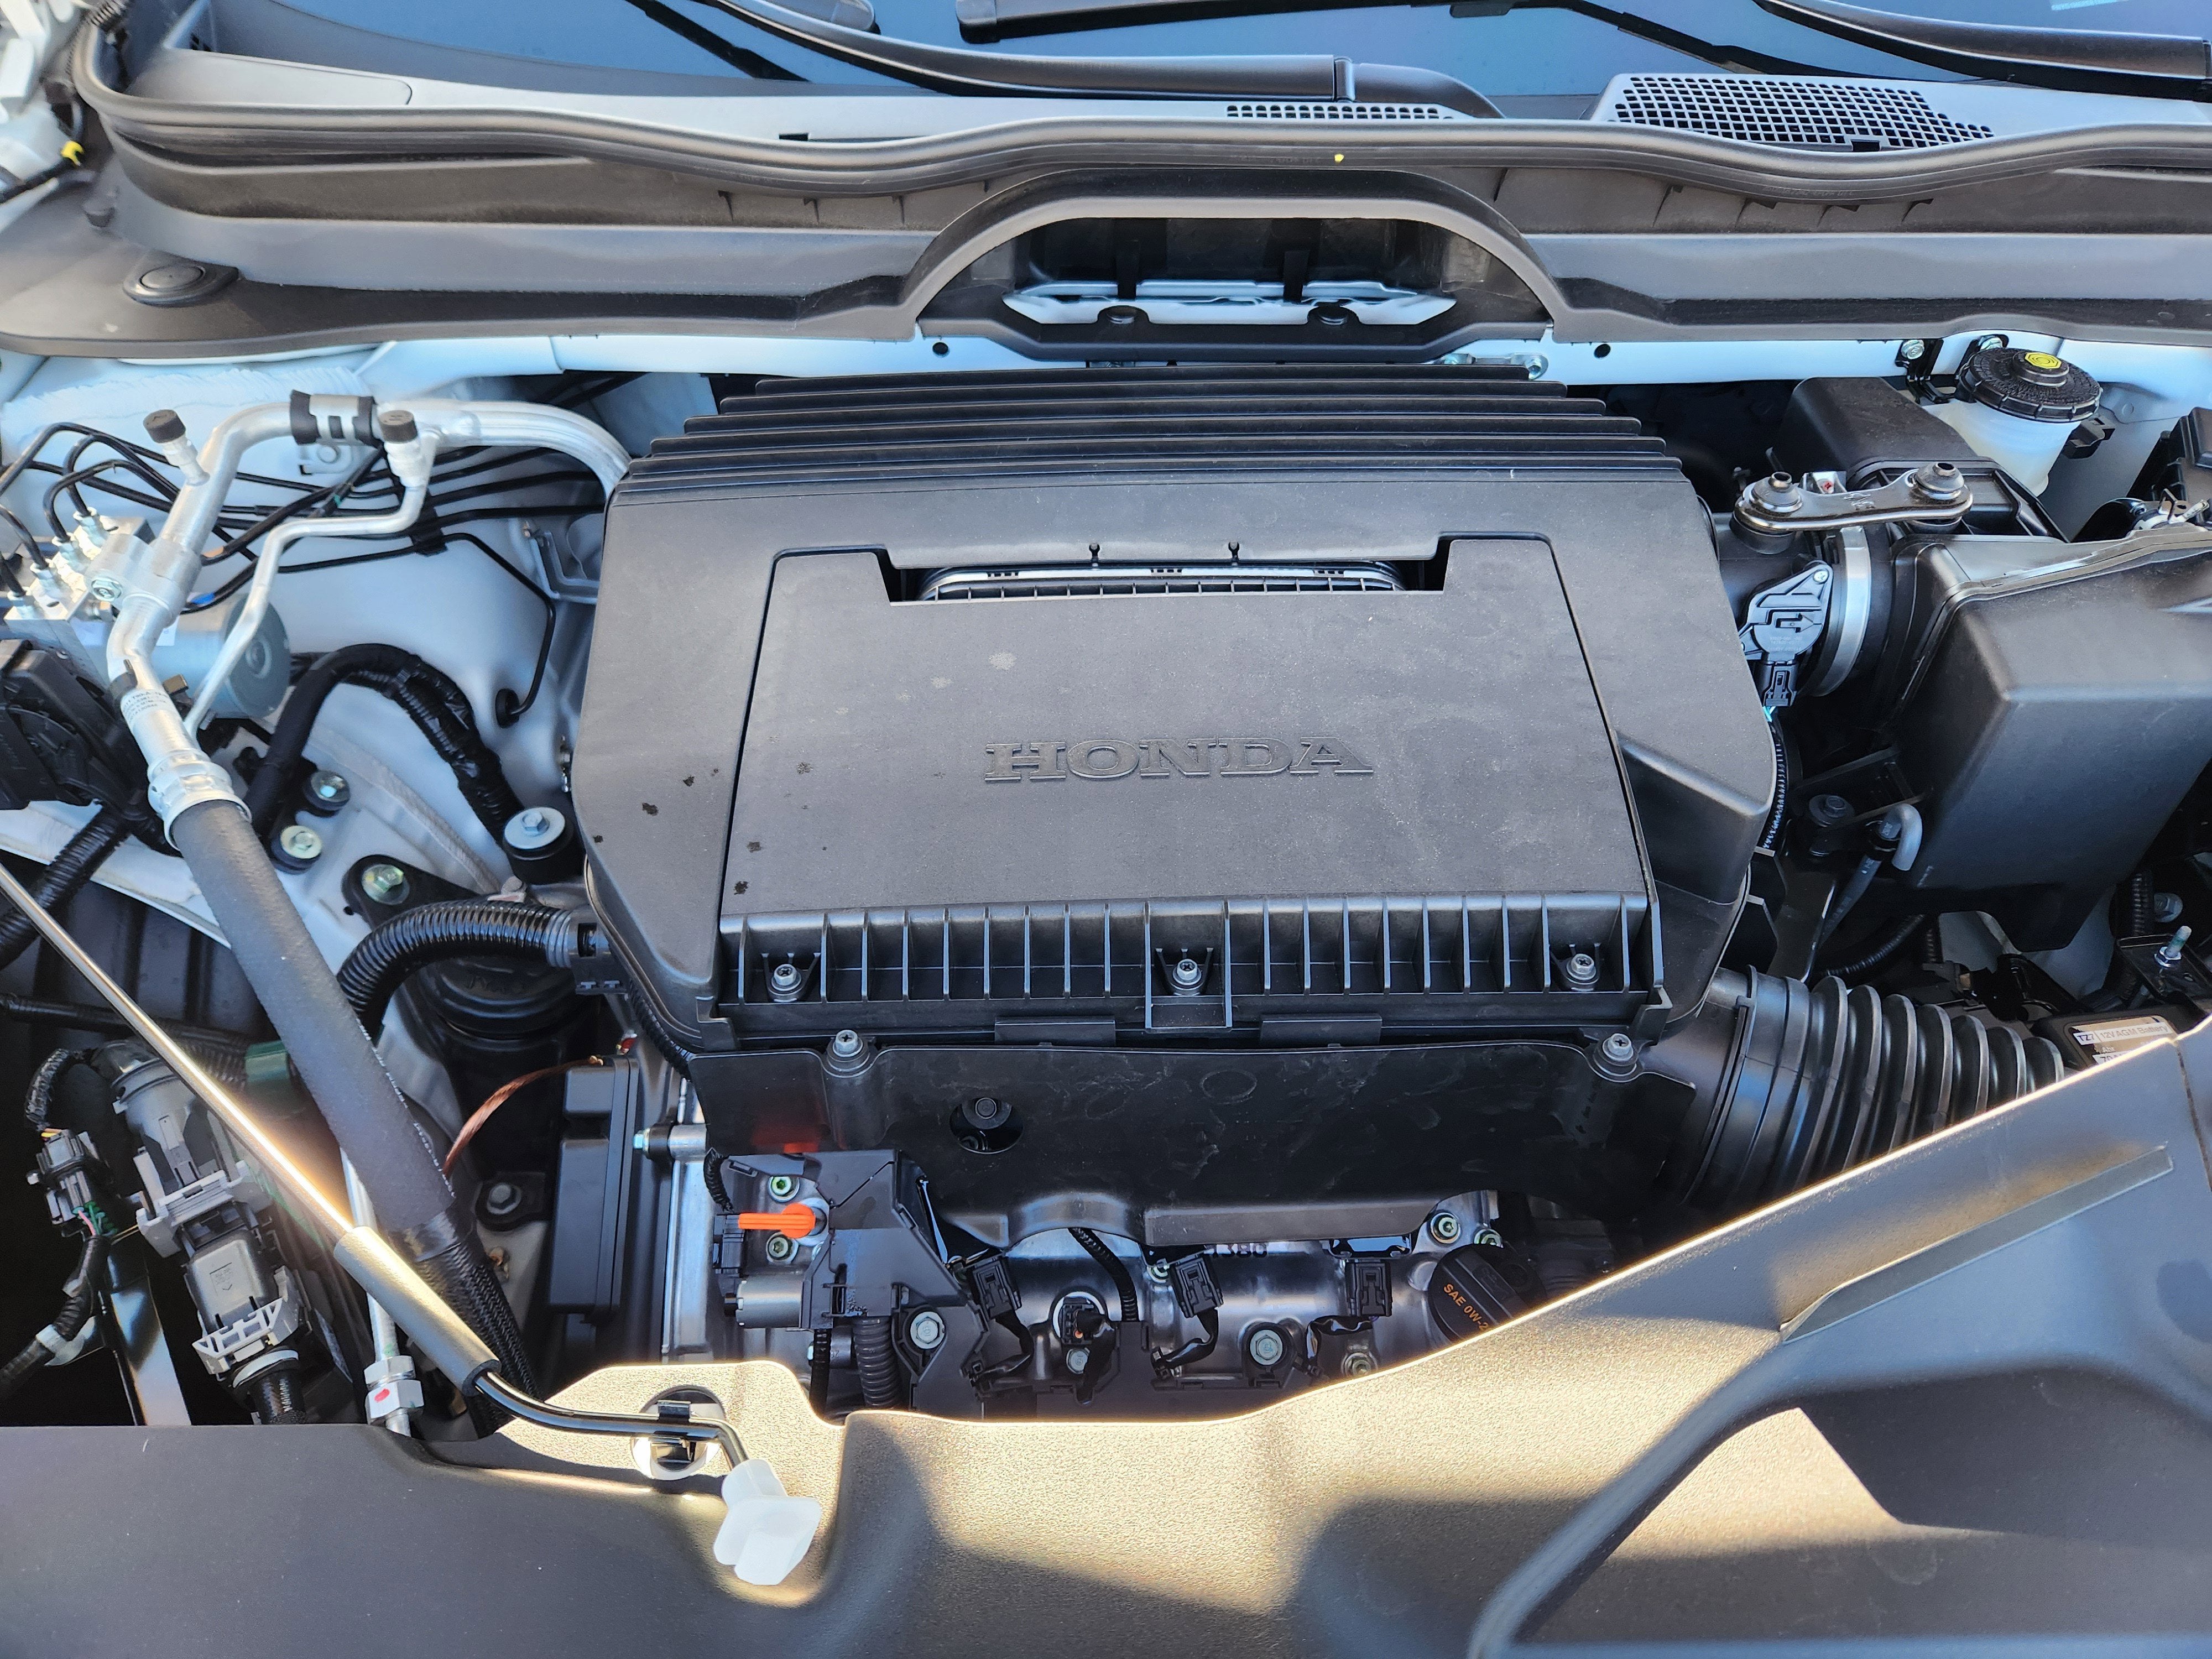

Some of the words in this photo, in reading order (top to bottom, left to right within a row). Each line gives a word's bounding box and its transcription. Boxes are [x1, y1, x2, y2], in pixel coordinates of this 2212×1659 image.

[985, 737, 1373, 780] HONDA
[2116, 1029, 2137, 1038] AGM
[2137, 1025, 2168, 1035] Battery
[1443, 1284, 1466, 1306] SAE
[1464, 1305, 1489, 1331] 0W-2
